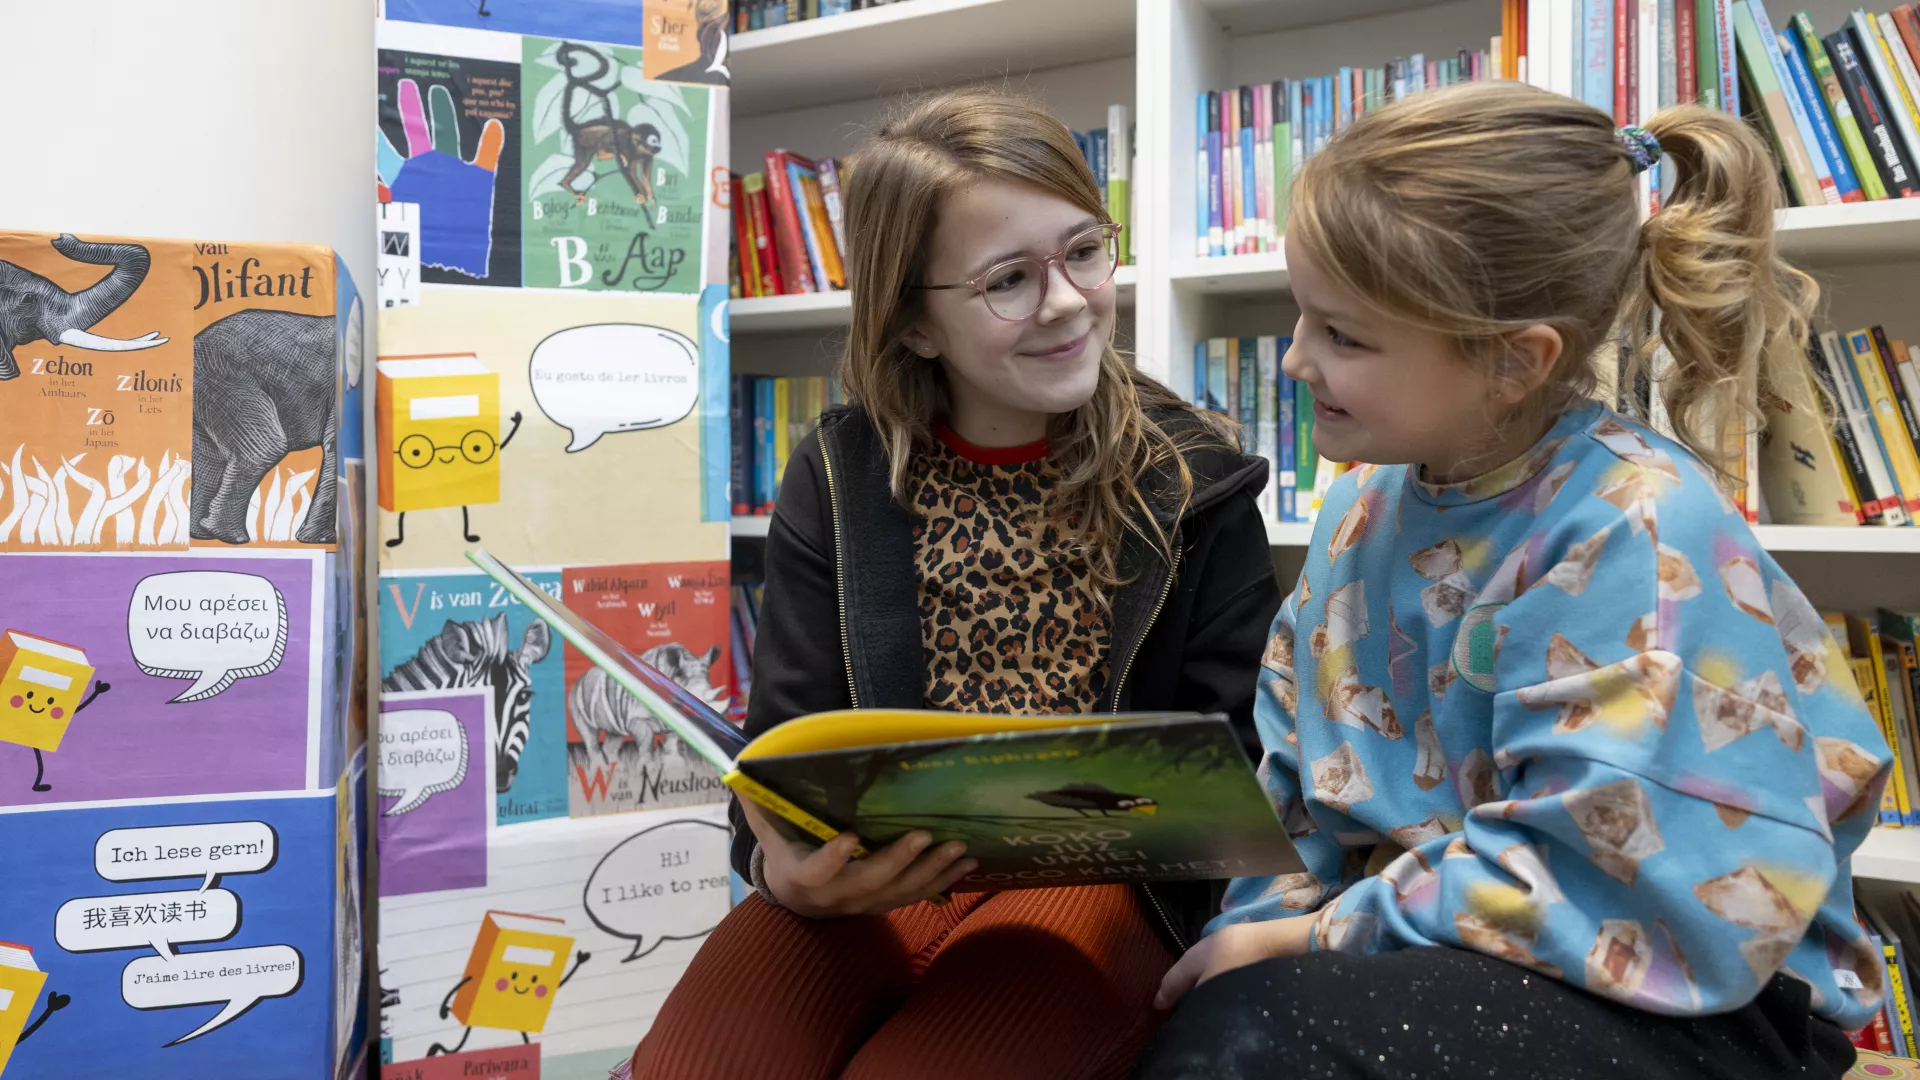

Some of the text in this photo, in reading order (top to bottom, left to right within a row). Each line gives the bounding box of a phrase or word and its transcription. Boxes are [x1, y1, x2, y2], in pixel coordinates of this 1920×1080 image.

[194, 242, 229, 256] van
[550, 236, 594, 288] B
[602, 232, 686, 291] Aap
[31, 356, 94, 377] Zehon
[534, 368, 688, 384] Eu gosto de ler livros
[116, 370, 184, 394] Zilonis
[37, 387, 87, 399] Amhaars
[84, 437, 119, 449] Japans
[144, 594, 269, 616] Μου αρέσει
[388, 583, 426, 631] V
[430, 591, 444, 611] is
[448, 590, 482, 607] van
[146, 623, 270, 643] να διαβάζω
[400, 726, 453, 745] αρέσει
[387, 747, 456, 767] διαβάζω
[574, 762, 618, 805] W
[610, 777, 633, 801] is van
[638, 763, 731, 804] Neushoo
[1003, 829, 1132, 846] KOKO
[111, 839, 265, 863] Ich lese gern!
[660, 850, 691, 869] Hi!
[964, 868, 1066, 883] COCO
[1079, 864, 1147, 876] KAN
[602, 874, 730, 904] I like to rea
[82, 901, 208, 930] 我喜欢读书
[183, 968, 215, 981] lire
[219, 965, 243, 977] des
[246, 960, 296, 976] livres!
